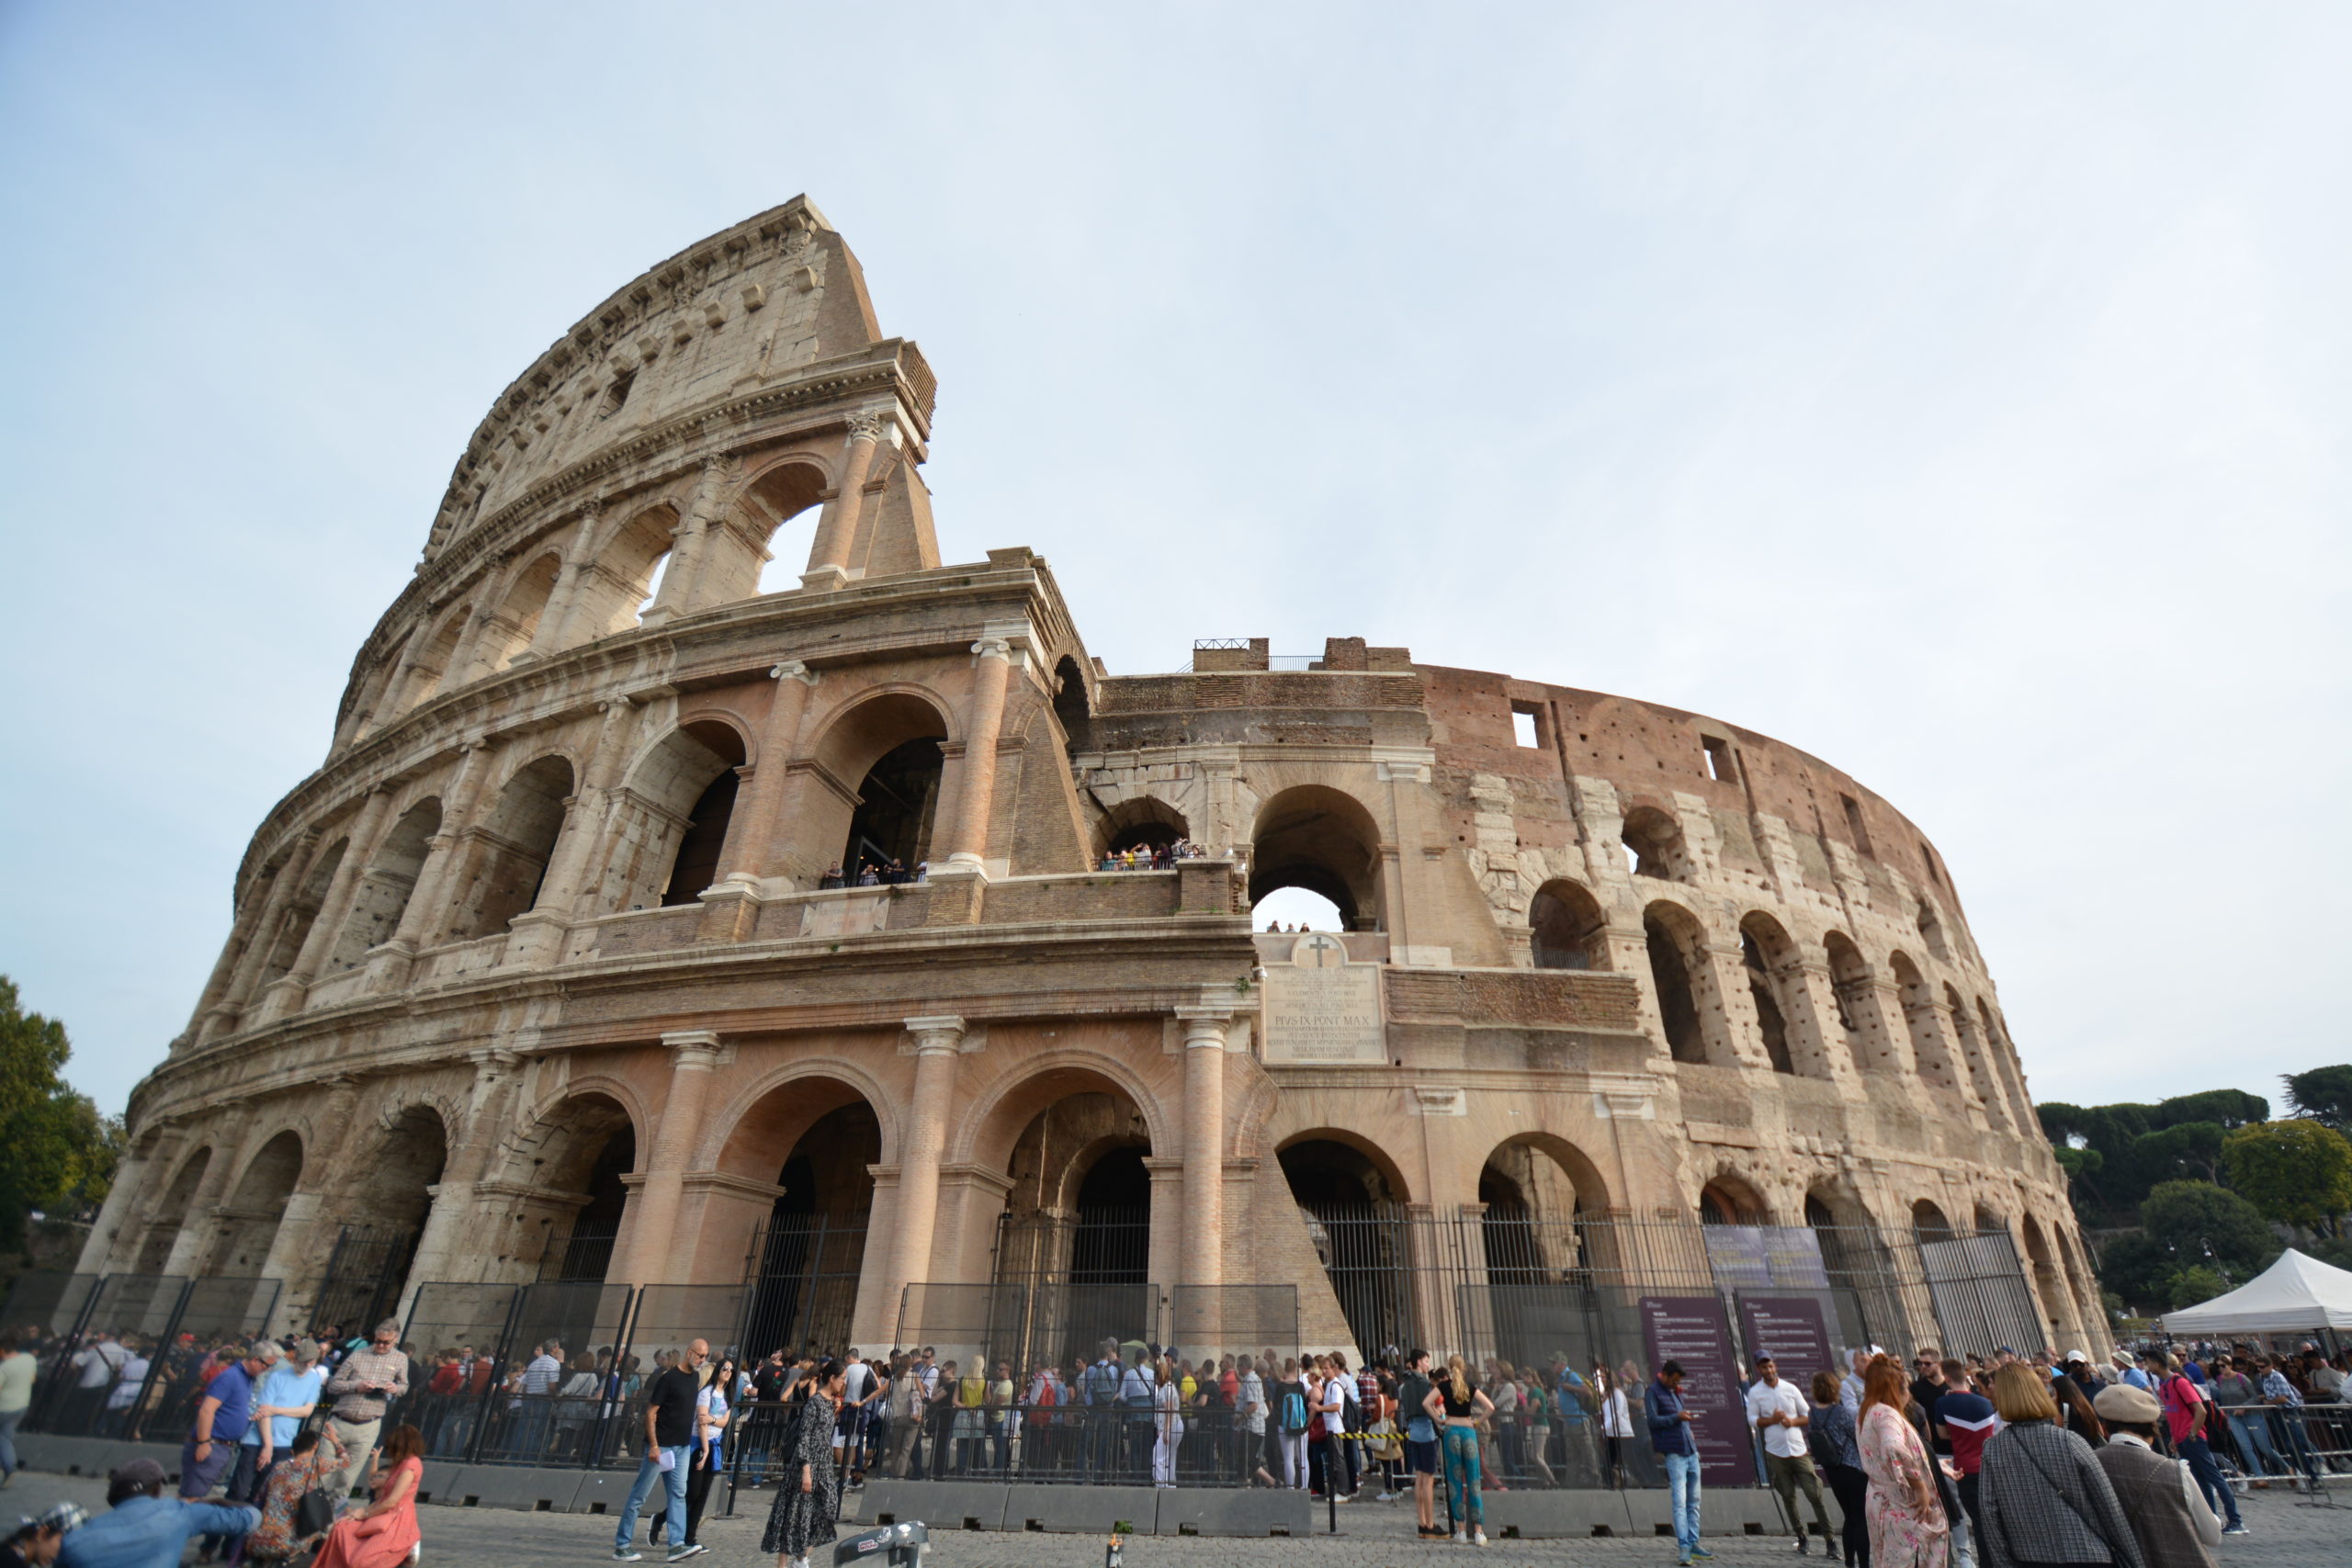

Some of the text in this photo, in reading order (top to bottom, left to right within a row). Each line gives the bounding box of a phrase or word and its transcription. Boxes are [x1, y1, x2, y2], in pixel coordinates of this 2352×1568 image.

[1275, 1016, 1370, 1025] PIVS IX PONT MAX
